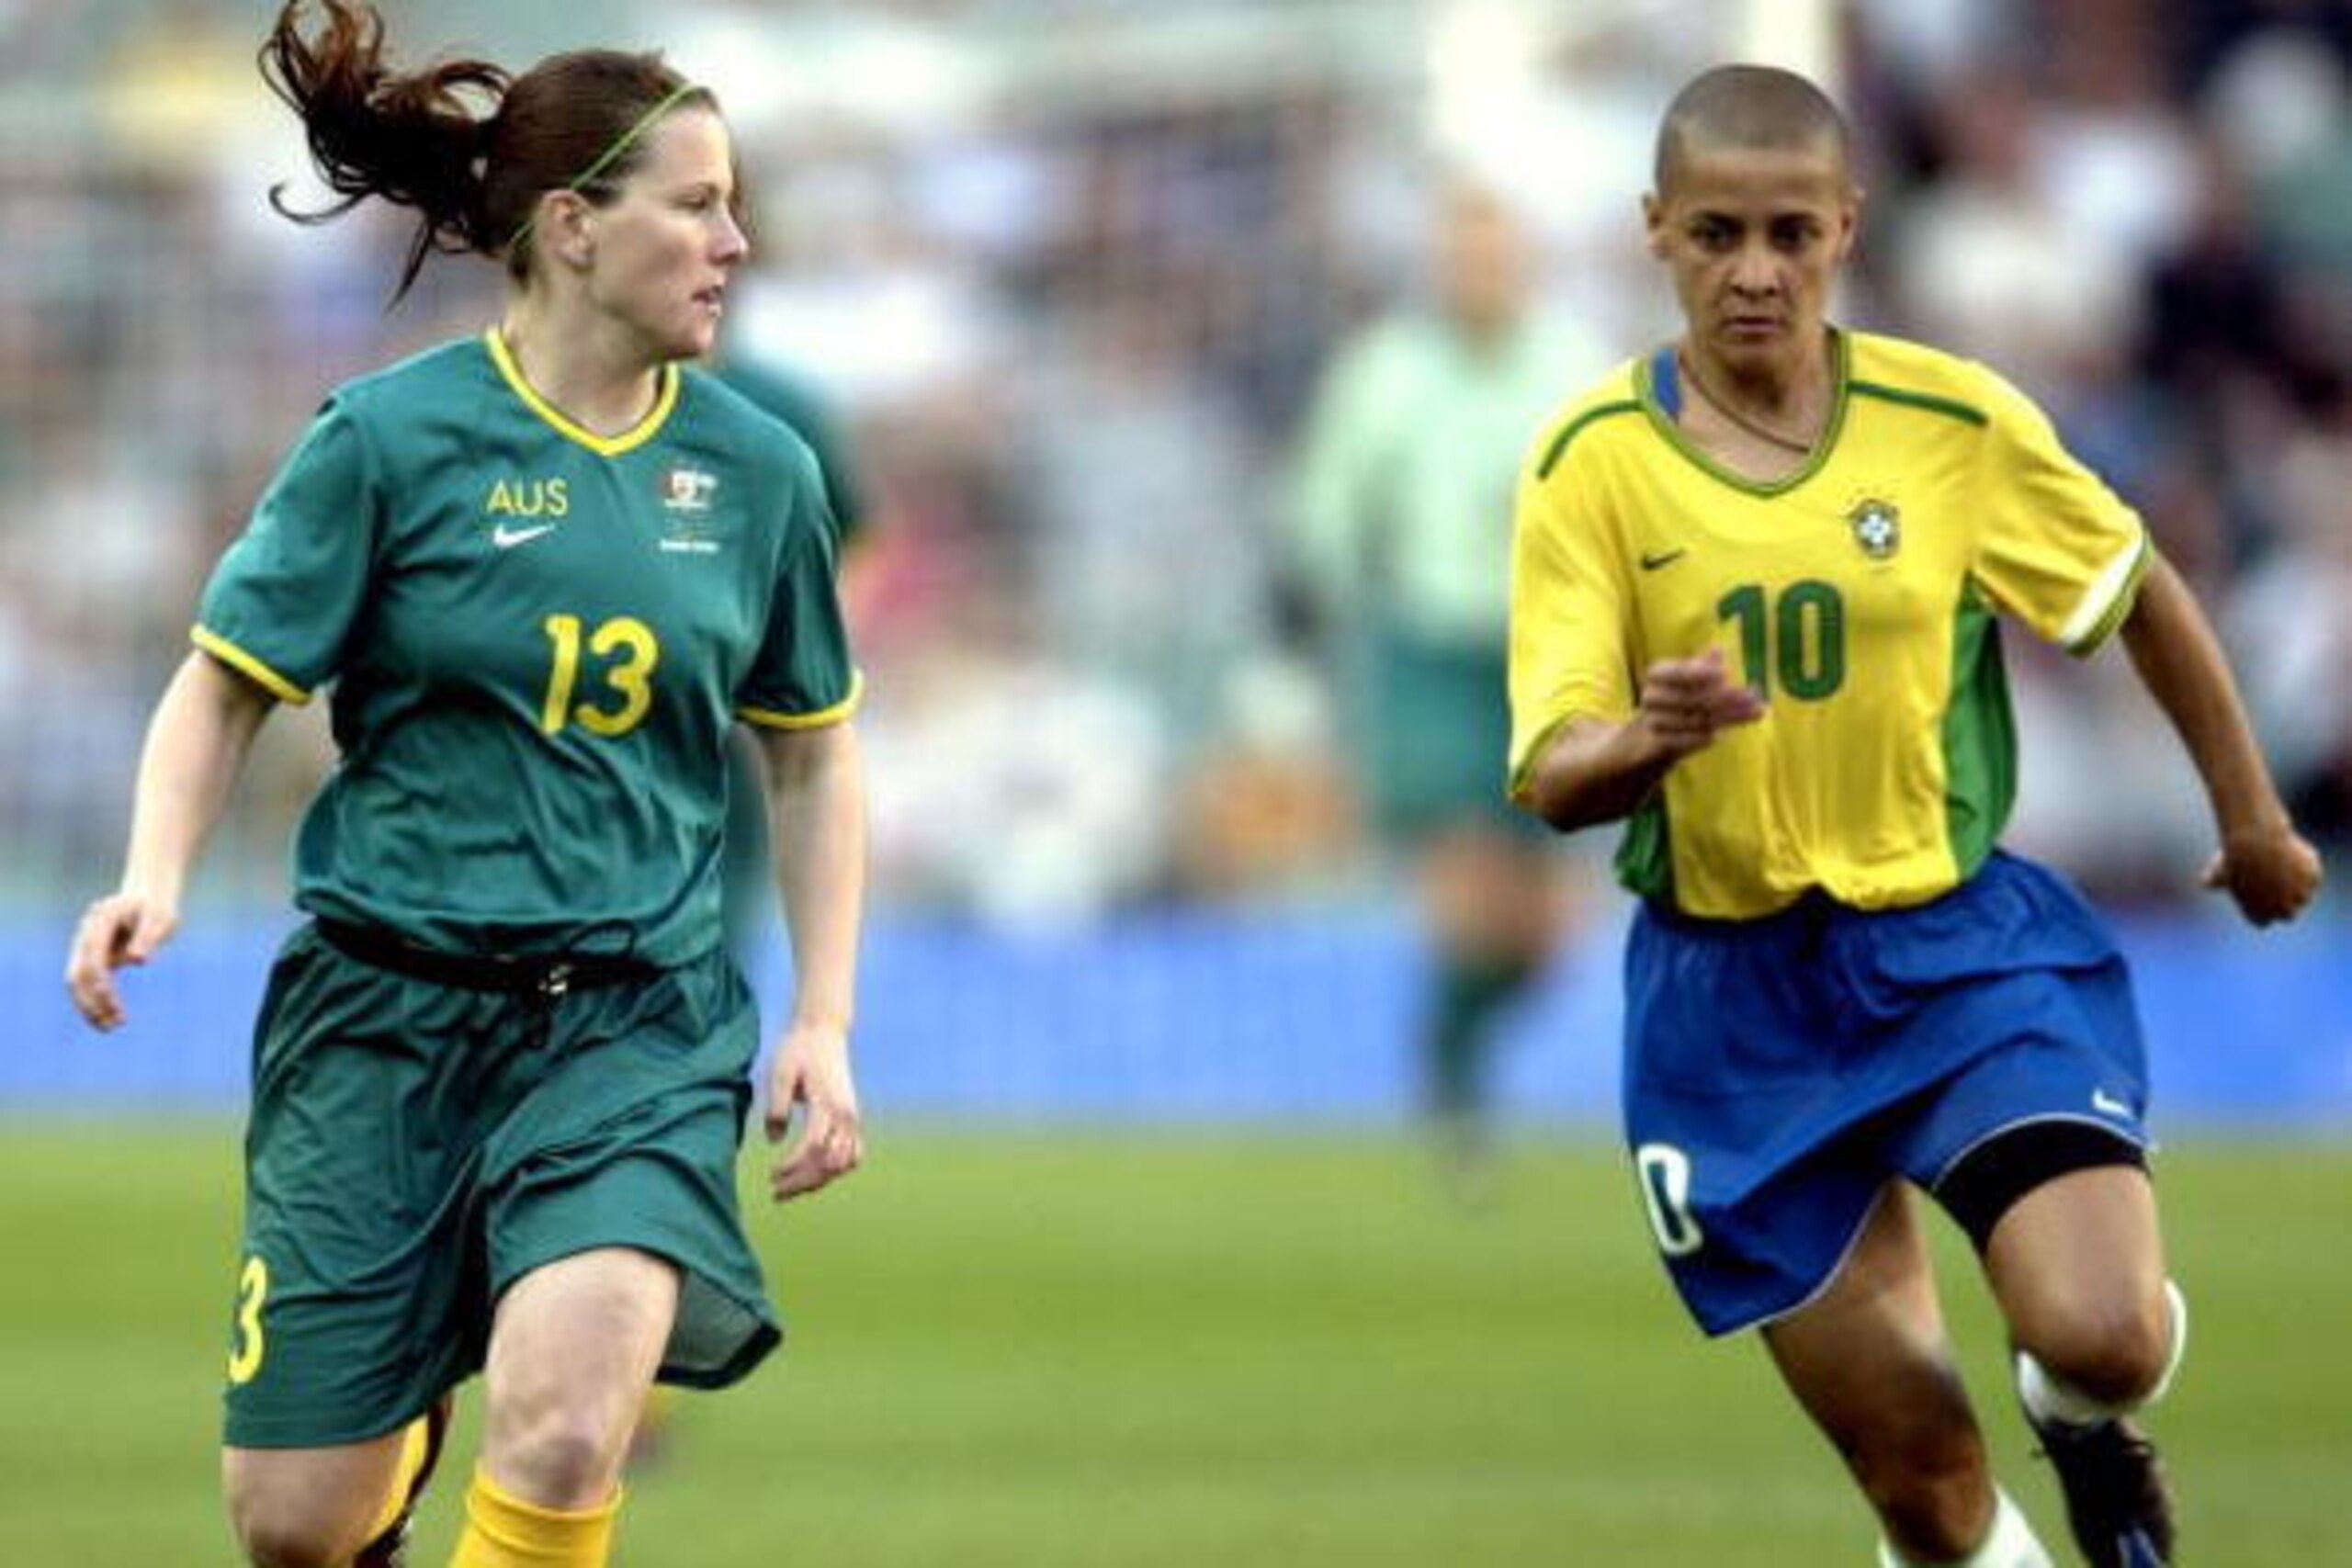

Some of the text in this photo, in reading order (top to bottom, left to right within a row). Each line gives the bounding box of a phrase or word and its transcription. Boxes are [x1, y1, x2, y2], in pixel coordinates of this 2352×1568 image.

[486, 478, 569, 517] AUS
[540, 614, 659, 737] 13
[1716, 579, 1846, 702] 10
